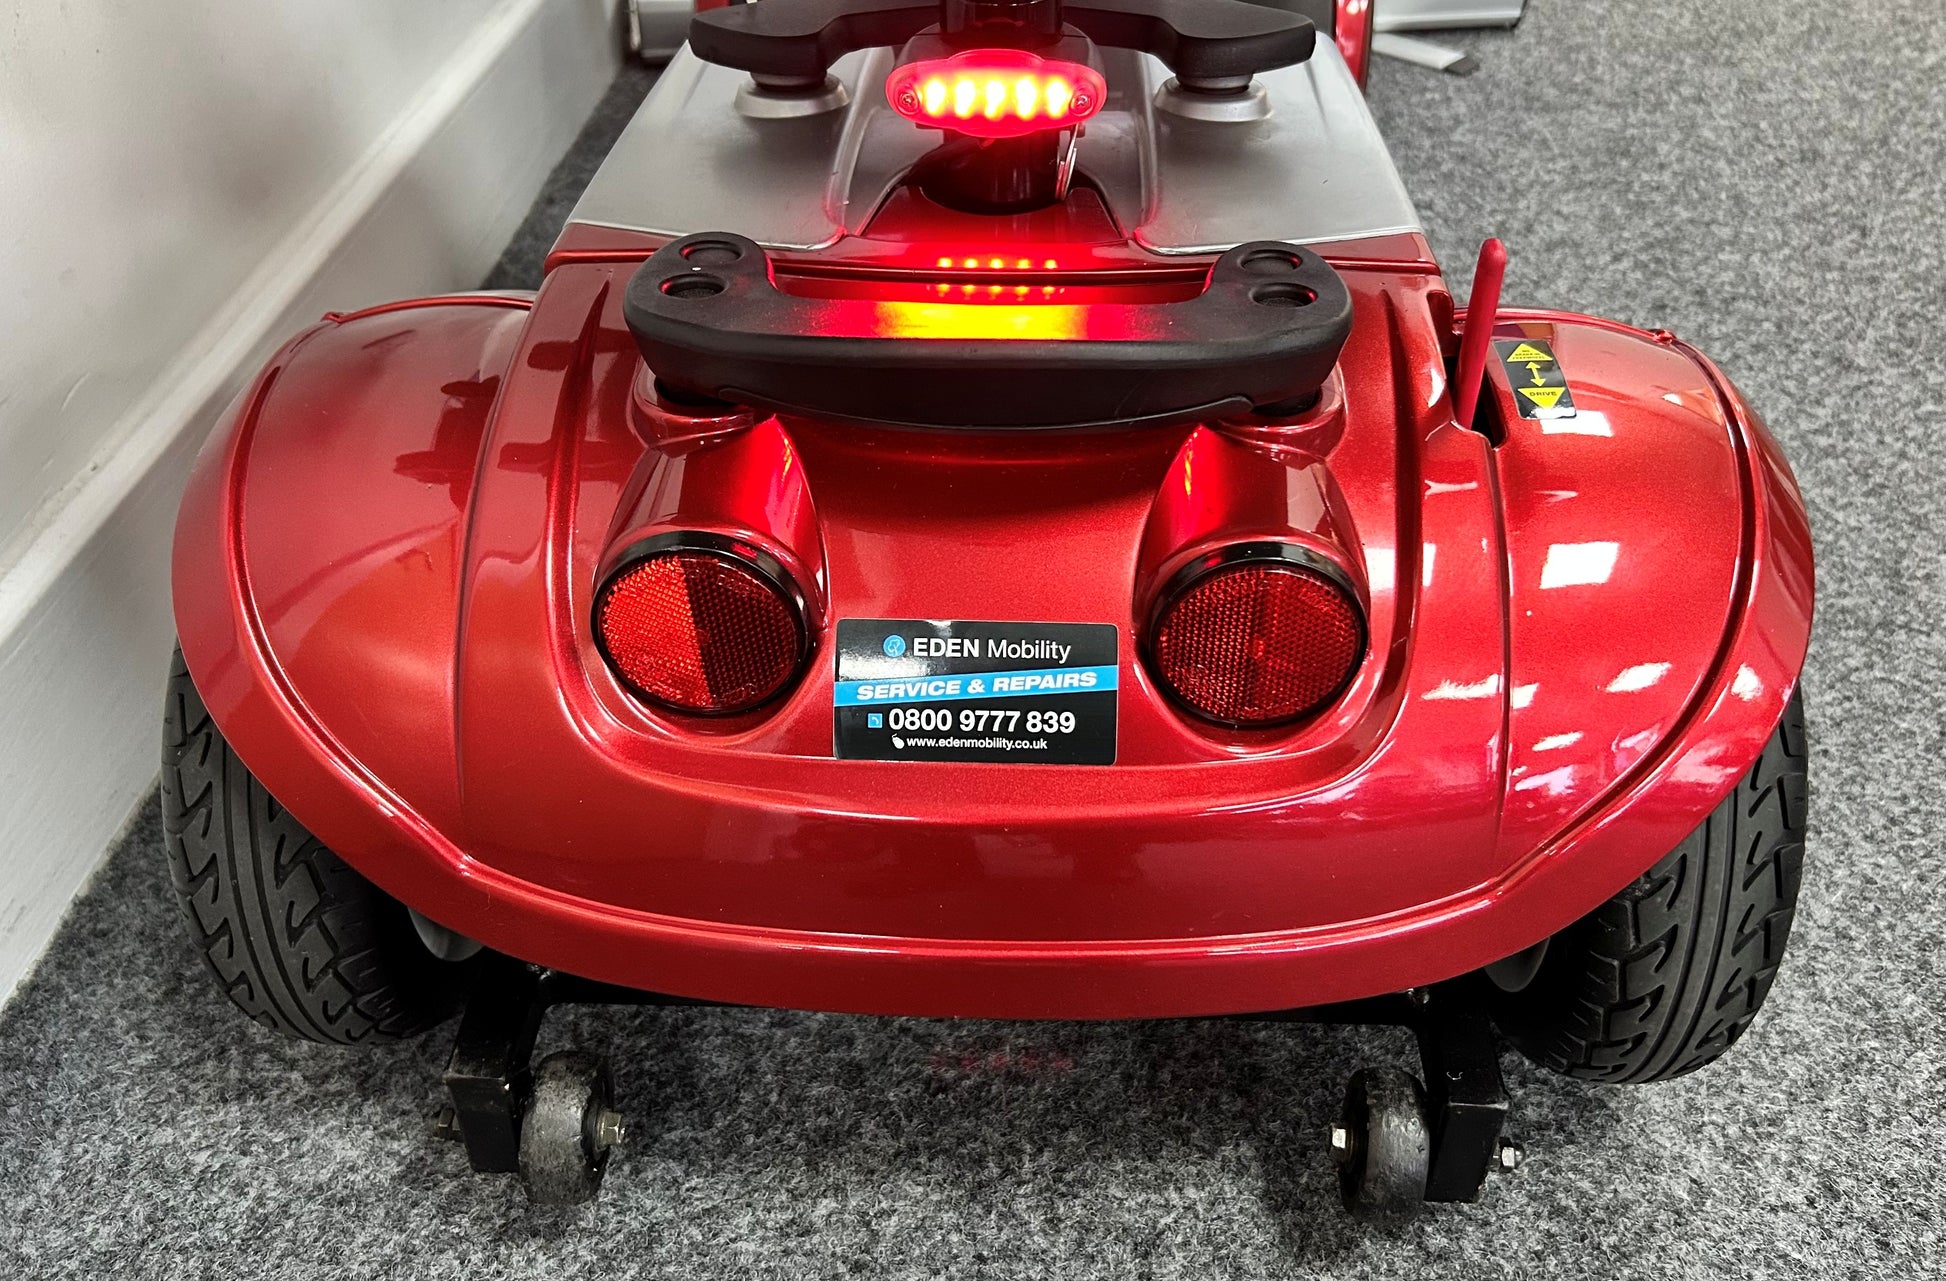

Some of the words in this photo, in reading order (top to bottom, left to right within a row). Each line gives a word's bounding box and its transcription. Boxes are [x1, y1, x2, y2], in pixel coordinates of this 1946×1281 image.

[913, 637, 980, 658] EDEN
[987, 639, 1072, 664] Mobility
[856, 680, 962, 701] SERVICE
[966, 678, 986, 694] &
[992, 671, 1098, 693] REPAIRS
[888, 708, 953, 732] 0800
[959, 709, 1021, 732] 9777
[1025, 710, 1076, 734] 839
[906, 736, 1048, 751] www.edenmobility.co.uk
